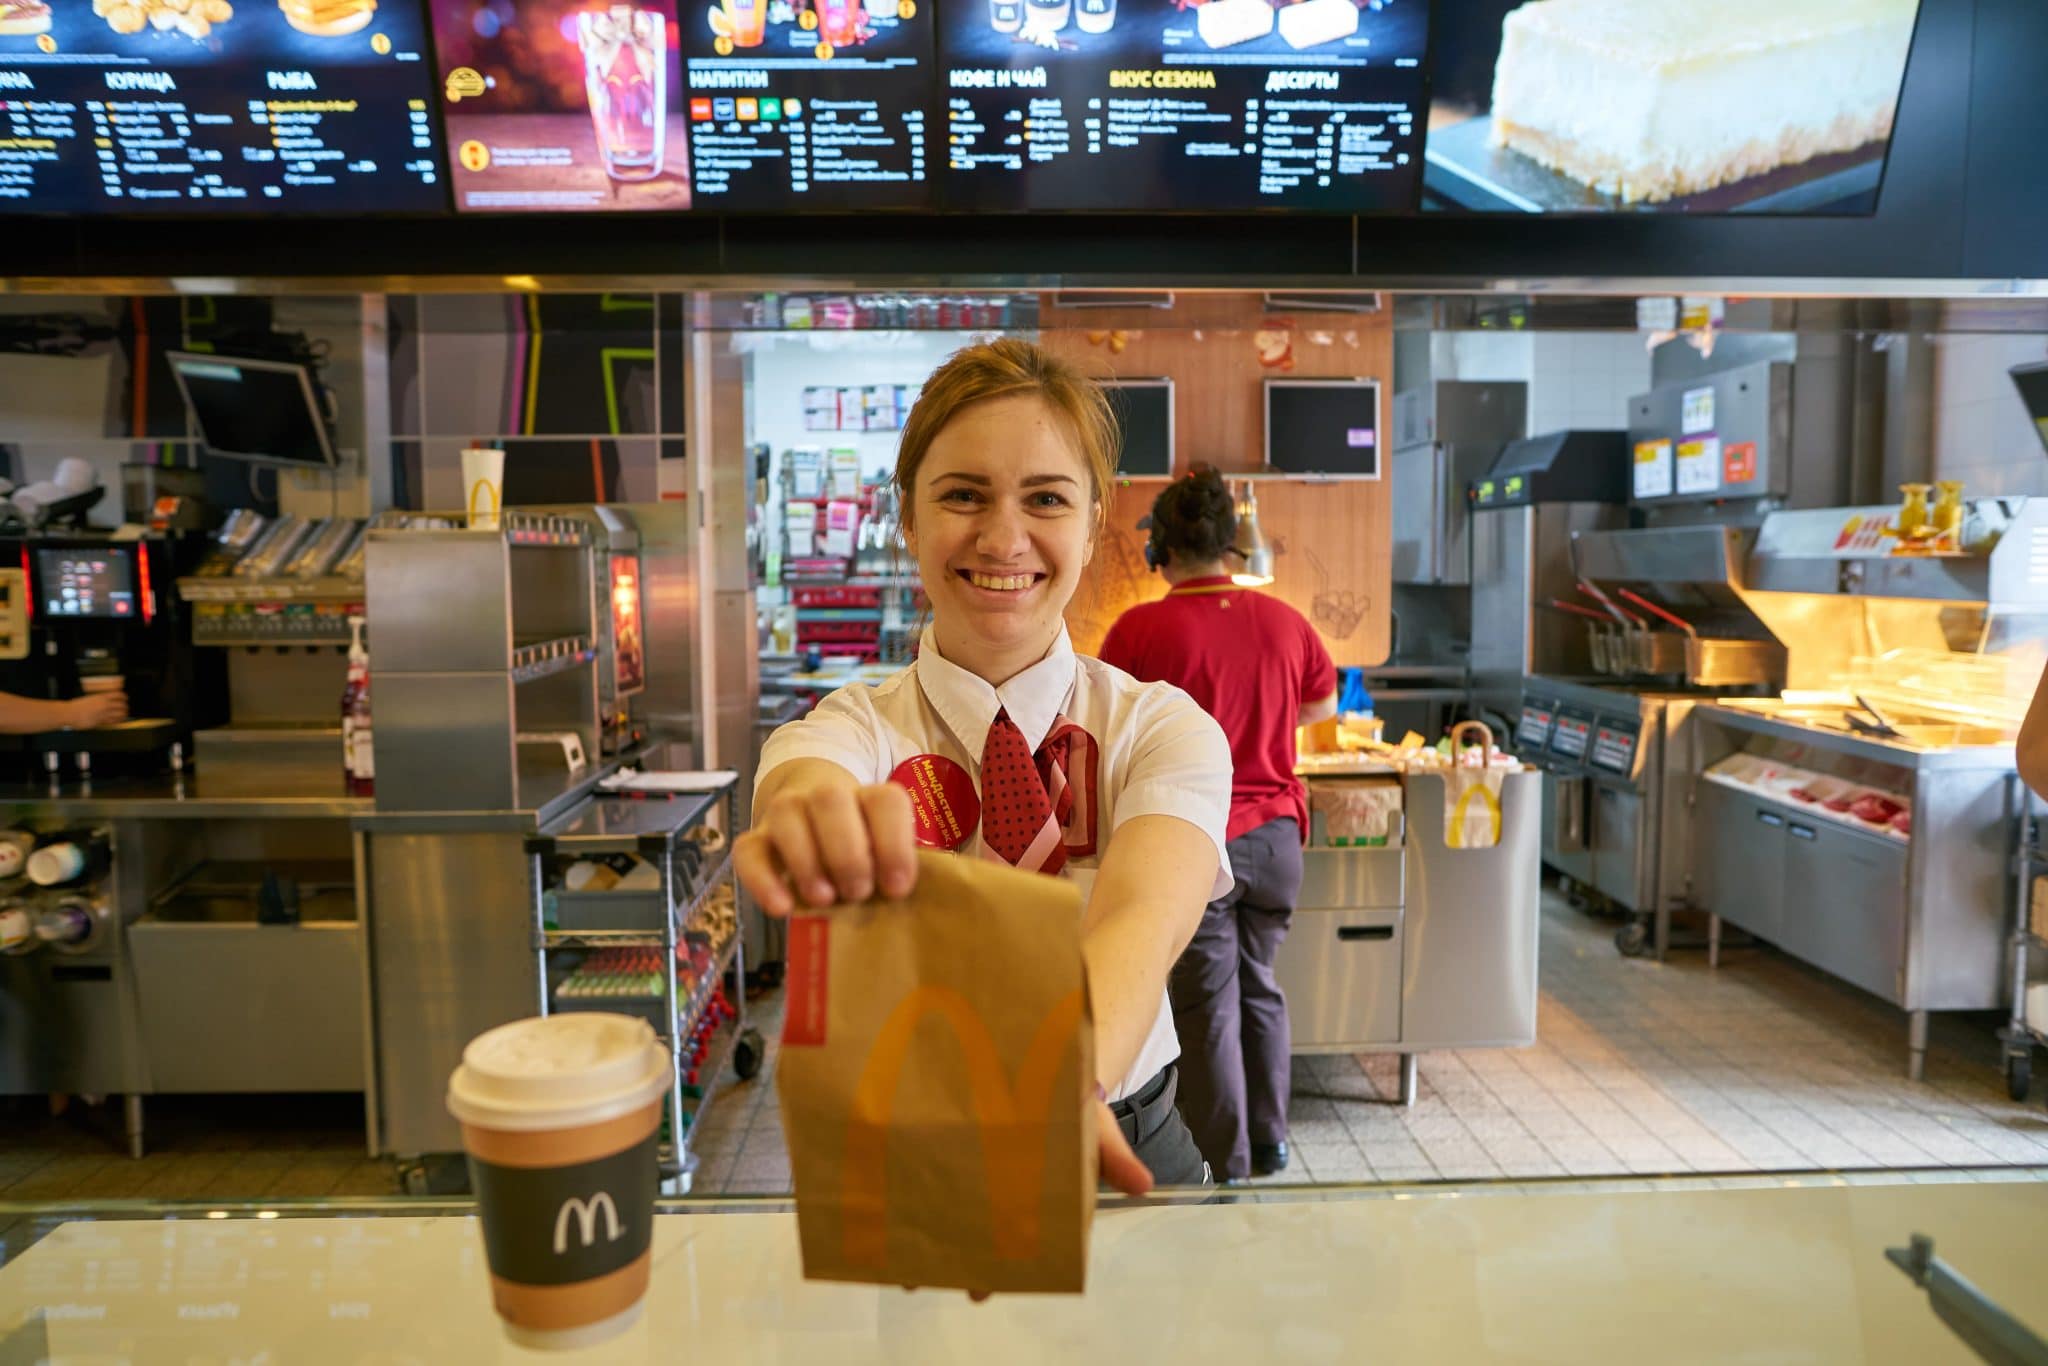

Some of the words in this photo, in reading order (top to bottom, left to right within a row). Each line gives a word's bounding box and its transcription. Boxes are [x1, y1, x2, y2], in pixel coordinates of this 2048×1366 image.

[104, 71, 177, 93] КУРИЦА
[266, 71, 317, 90] РЫБА
[689, 71, 769, 89] НАПИТКИ
[950, 69, 996, 88] КОФЕ
[996, 69, 1011, 88] И
[1011, 65, 1047, 88] ЧАЙ
[1109, 70, 1152, 88] ВКУС
[1153, 70, 1217, 88] СЕЗОНА
[1264, 71, 1340, 92] ДЕСЕРТЫ
[921, 760, 961, 839] МакДоставка
